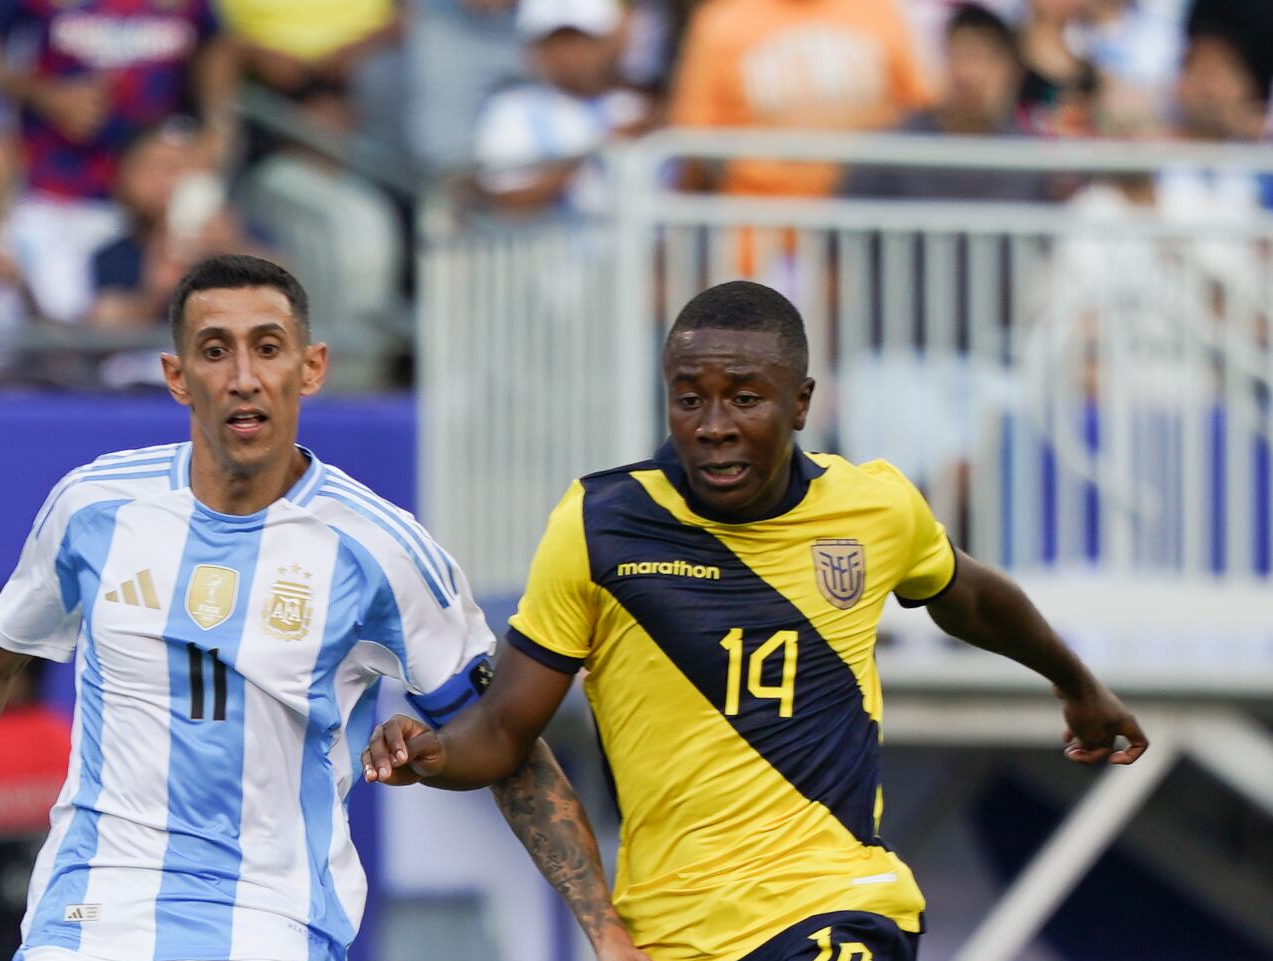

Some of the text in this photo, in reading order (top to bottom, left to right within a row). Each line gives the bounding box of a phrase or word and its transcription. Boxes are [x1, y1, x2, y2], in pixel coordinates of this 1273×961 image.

[617, 560, 721, 580] marathon
[187, 642, 227, 721] 11
[719, 627, 799, 718] 14
